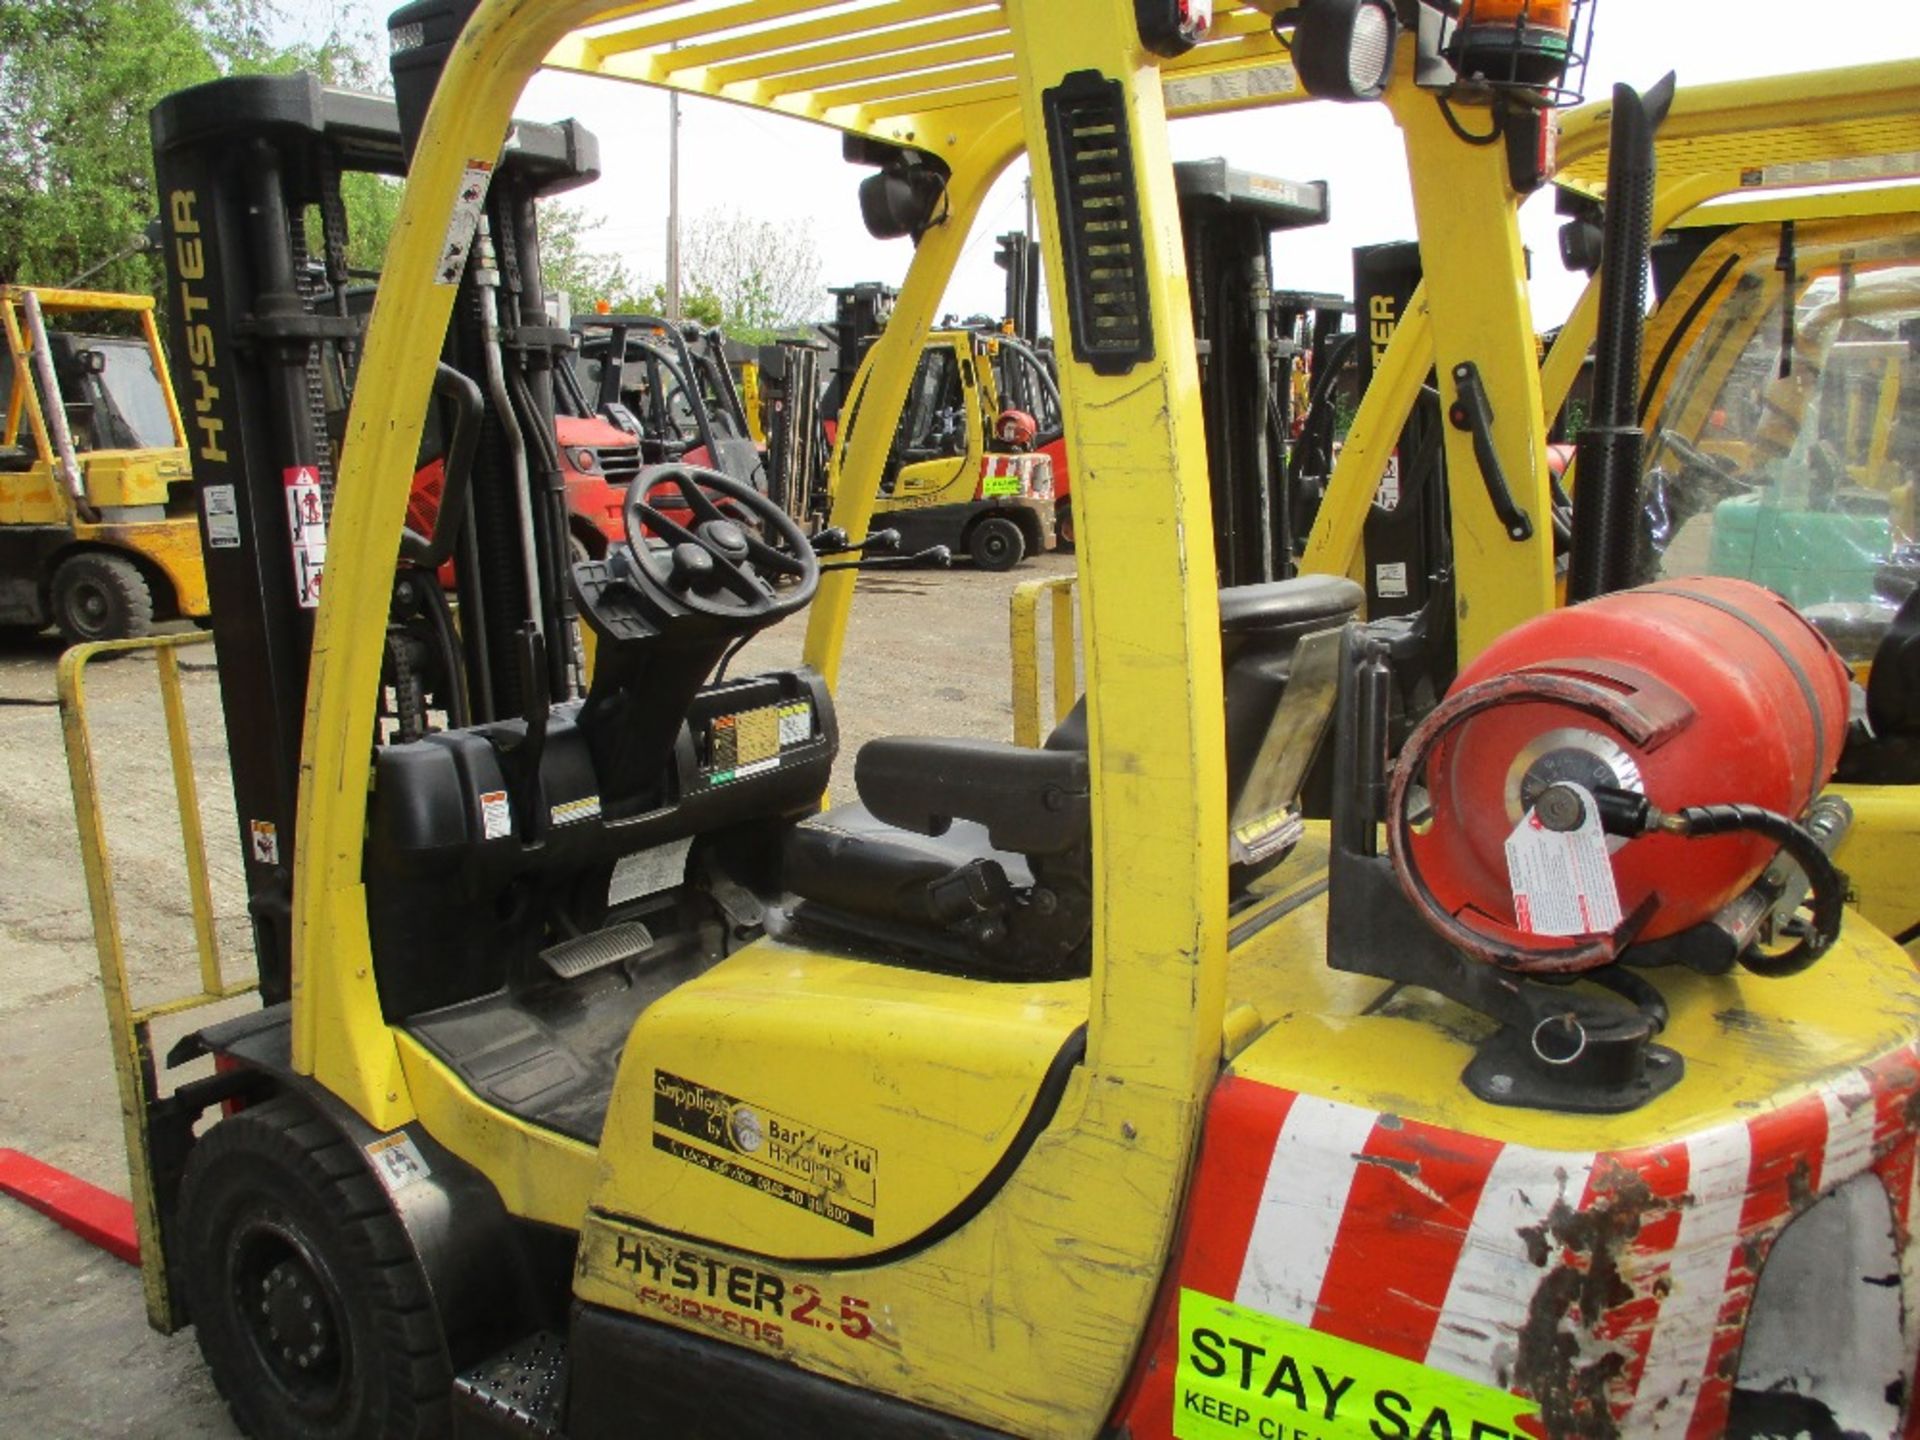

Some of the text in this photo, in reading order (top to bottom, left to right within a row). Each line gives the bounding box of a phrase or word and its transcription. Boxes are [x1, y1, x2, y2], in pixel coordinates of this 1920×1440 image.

[170, 189, 228, 463] HYSTER
[615, 1236, 874, 1340] HYSTER 2.5
[1183, 1389, 1250, 1427] KEEP
[1189, 1327, 1541, 1440] STAY SA
